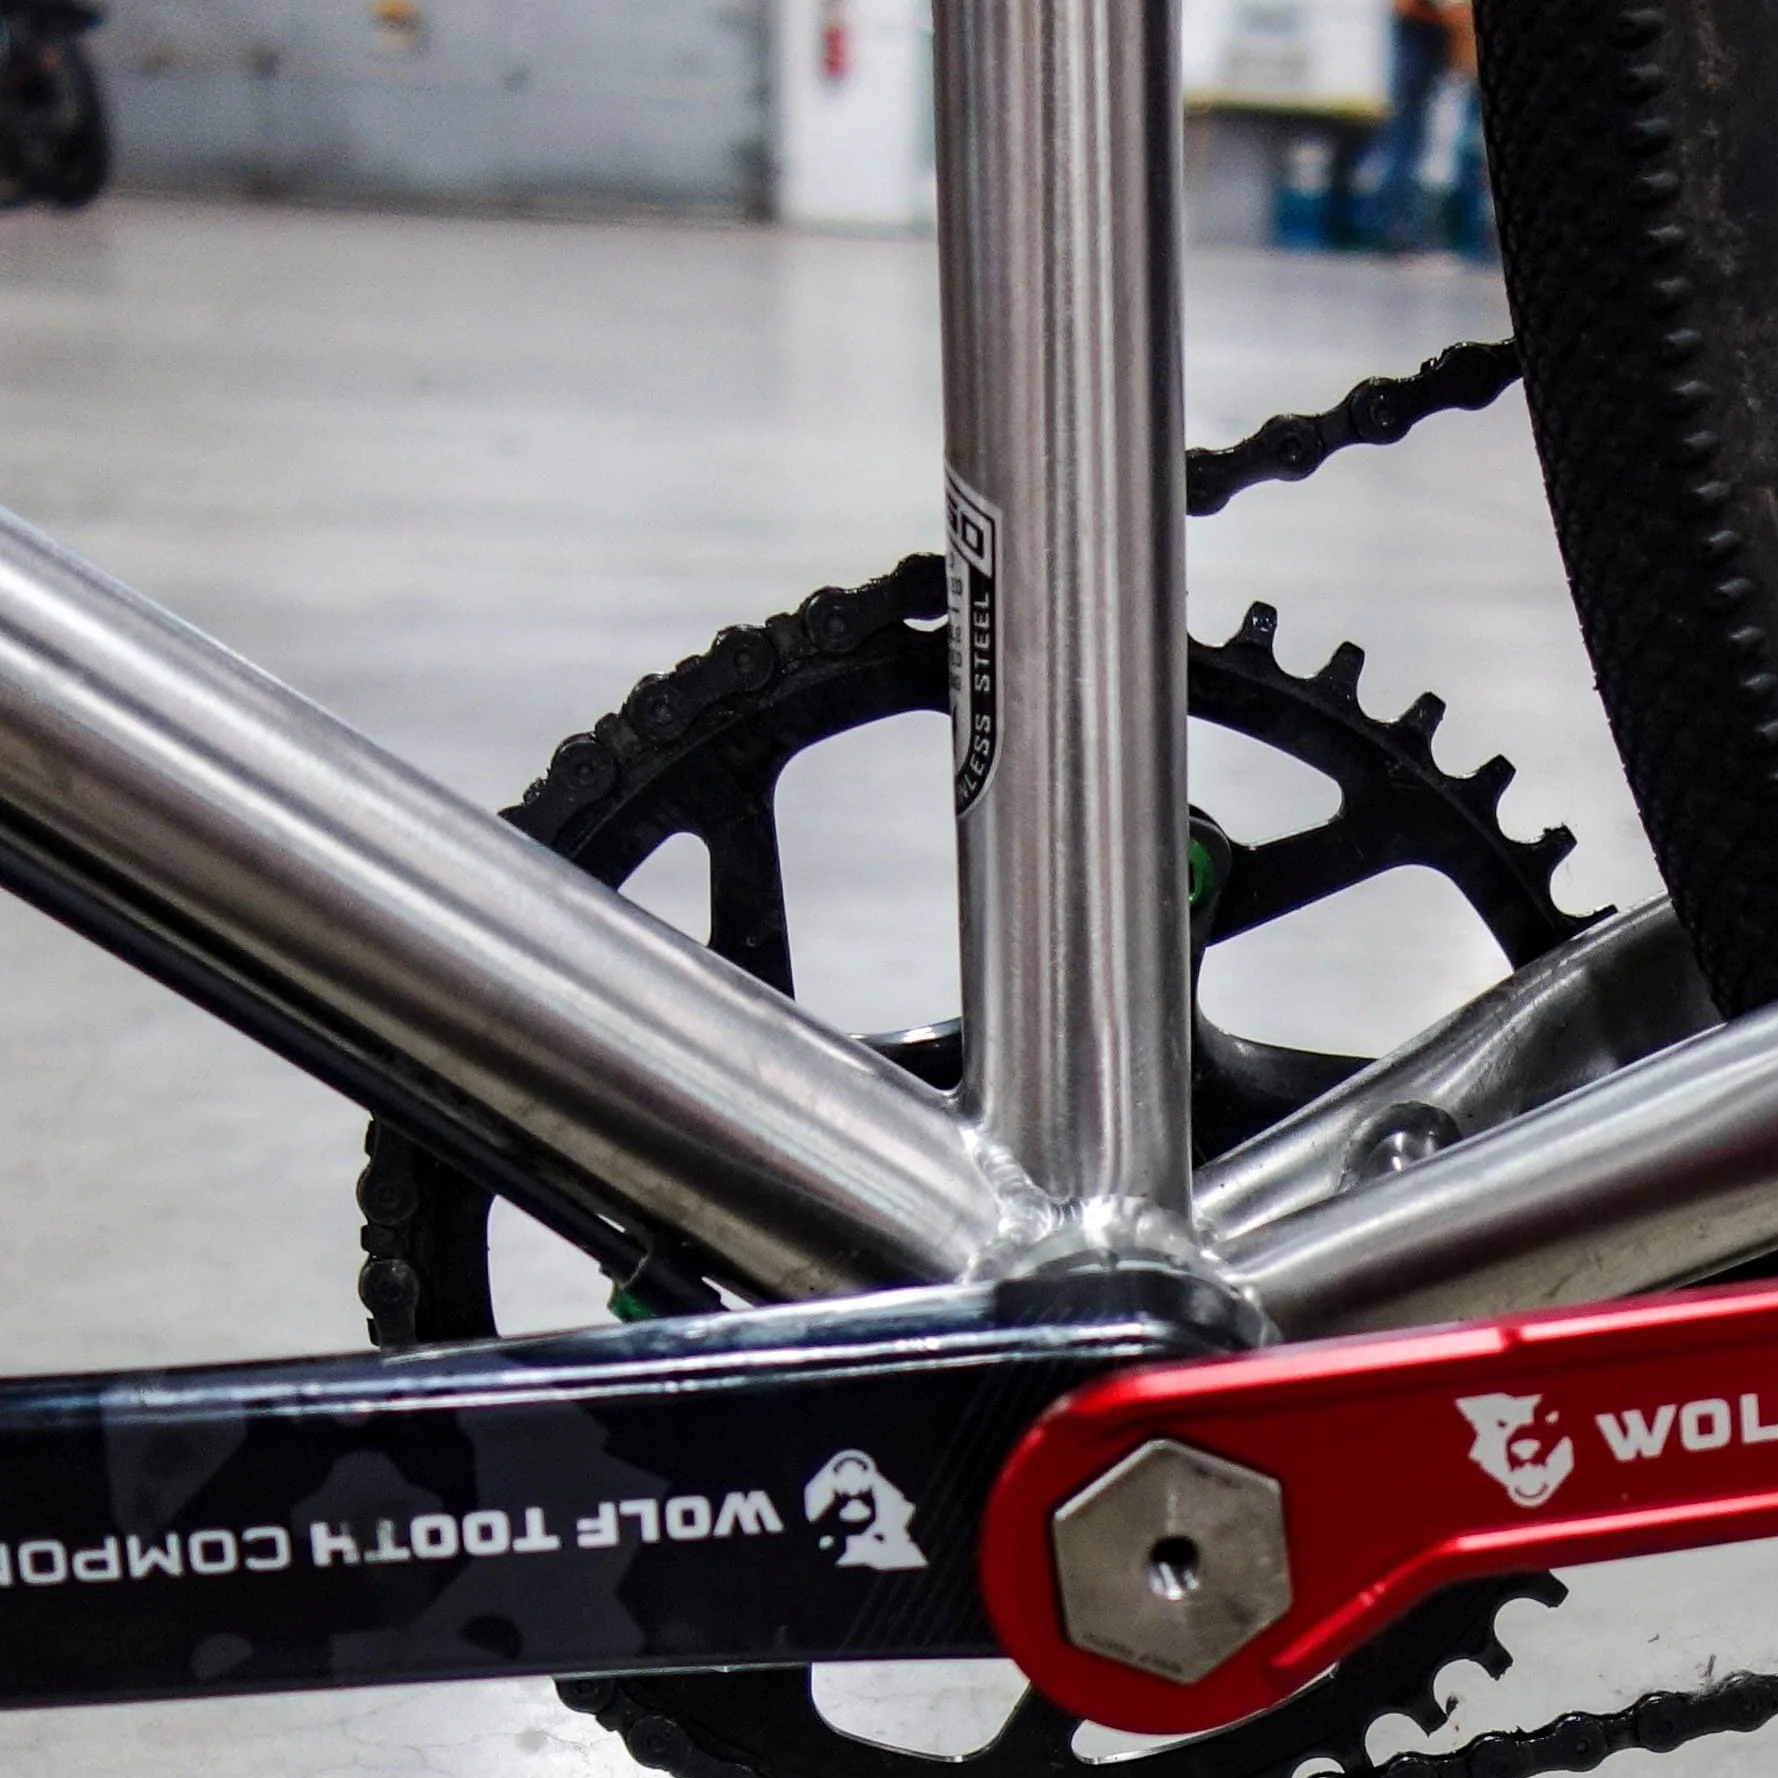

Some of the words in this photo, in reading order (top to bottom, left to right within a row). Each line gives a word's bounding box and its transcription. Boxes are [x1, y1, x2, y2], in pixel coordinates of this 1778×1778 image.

[973, 590, 991, 692] STEEL
[309, 1506, 560, 1567] TOOTH
[576, 1489, 784, 1548] WOLF
[0, 1526, 291, 1587] COMPO
